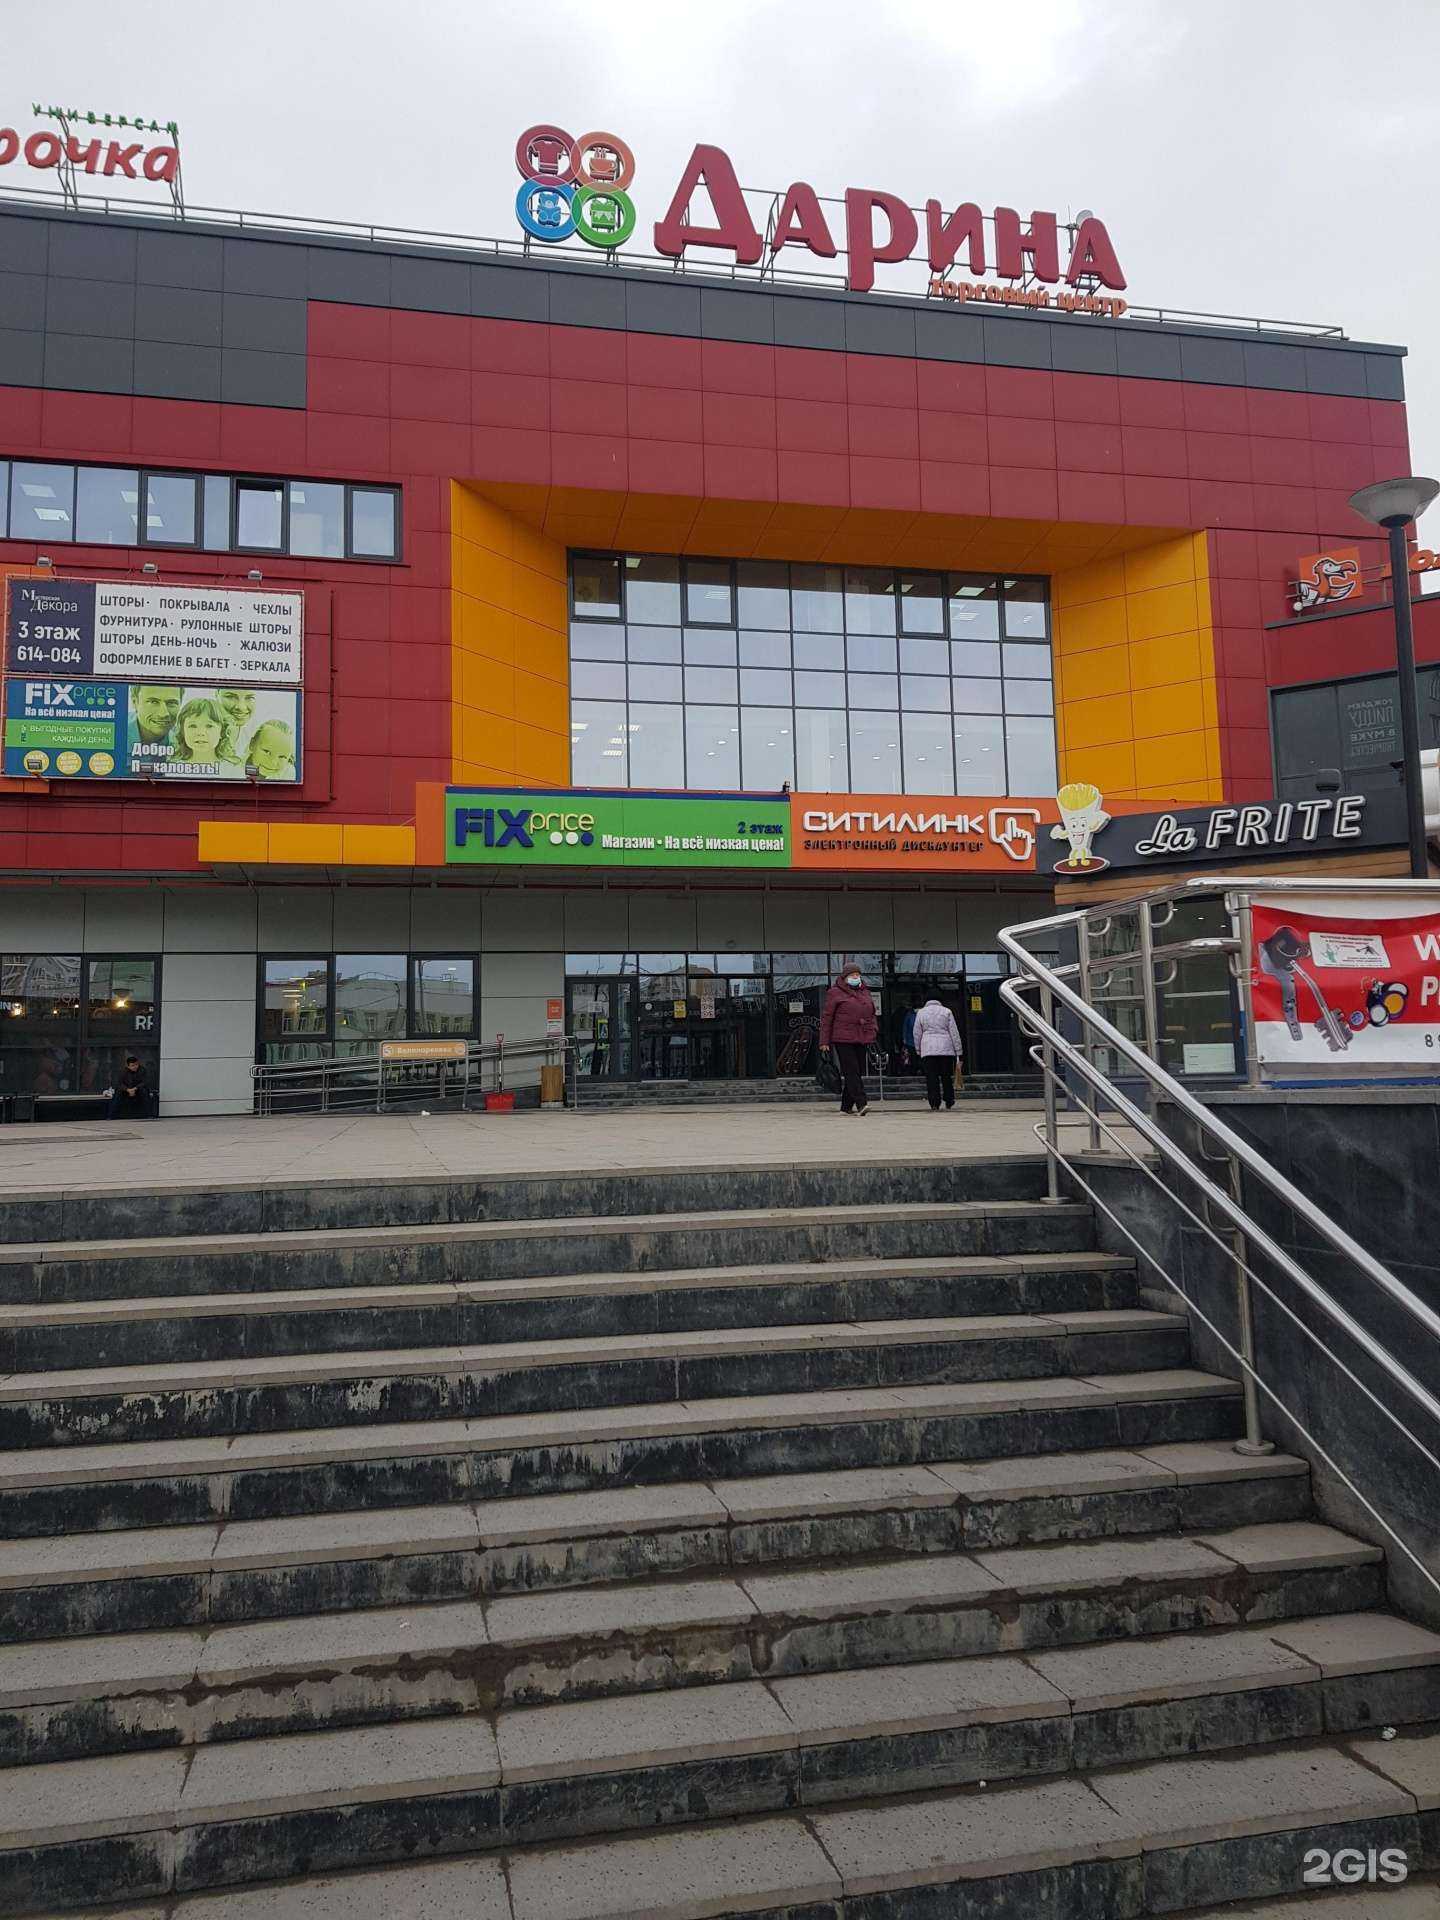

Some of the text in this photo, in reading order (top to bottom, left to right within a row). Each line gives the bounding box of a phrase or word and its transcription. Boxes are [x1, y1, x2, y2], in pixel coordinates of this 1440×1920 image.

[30, 599, 78, 614] Декора
[100, 595, 292, 616] ШТОРЫ ПОКРЫВАЛА ЧЕХЛЫ
[18, 621, 81, 641] 3 этаж
[100, 615, 292, 635] ФУРНИТУРА РУЛОННЫЕ ШТОРЫ
[100, 633, 292, 653] ШТОРЫ ДЕНЬ-НОЧЬ ЖАЛЮЗИ
[17, 645, 82, 664] 614-084
[100, 653, 291, 673] ОФОРМЛЕНИЕ В БАГЕТ ЗЕРКАЛА
[25, 707, 37, 717] На
[55, 709, 89, 718] низкая
[131, 742, 175, 758] Добро
[738, 821, 783, 834] 2 этаж
[803, 811, 985, 834] СИТИЛИНК
[1135, 795, 1367, 857] La FRITE
[602, 834, 785, 852] Магазин На всё низкая цена!
[804, 838, 985, 853] ЭЛЕКТРОННЫЙ ДИСКАУНТЕР
[1421, 976, 1440, 1007] P
